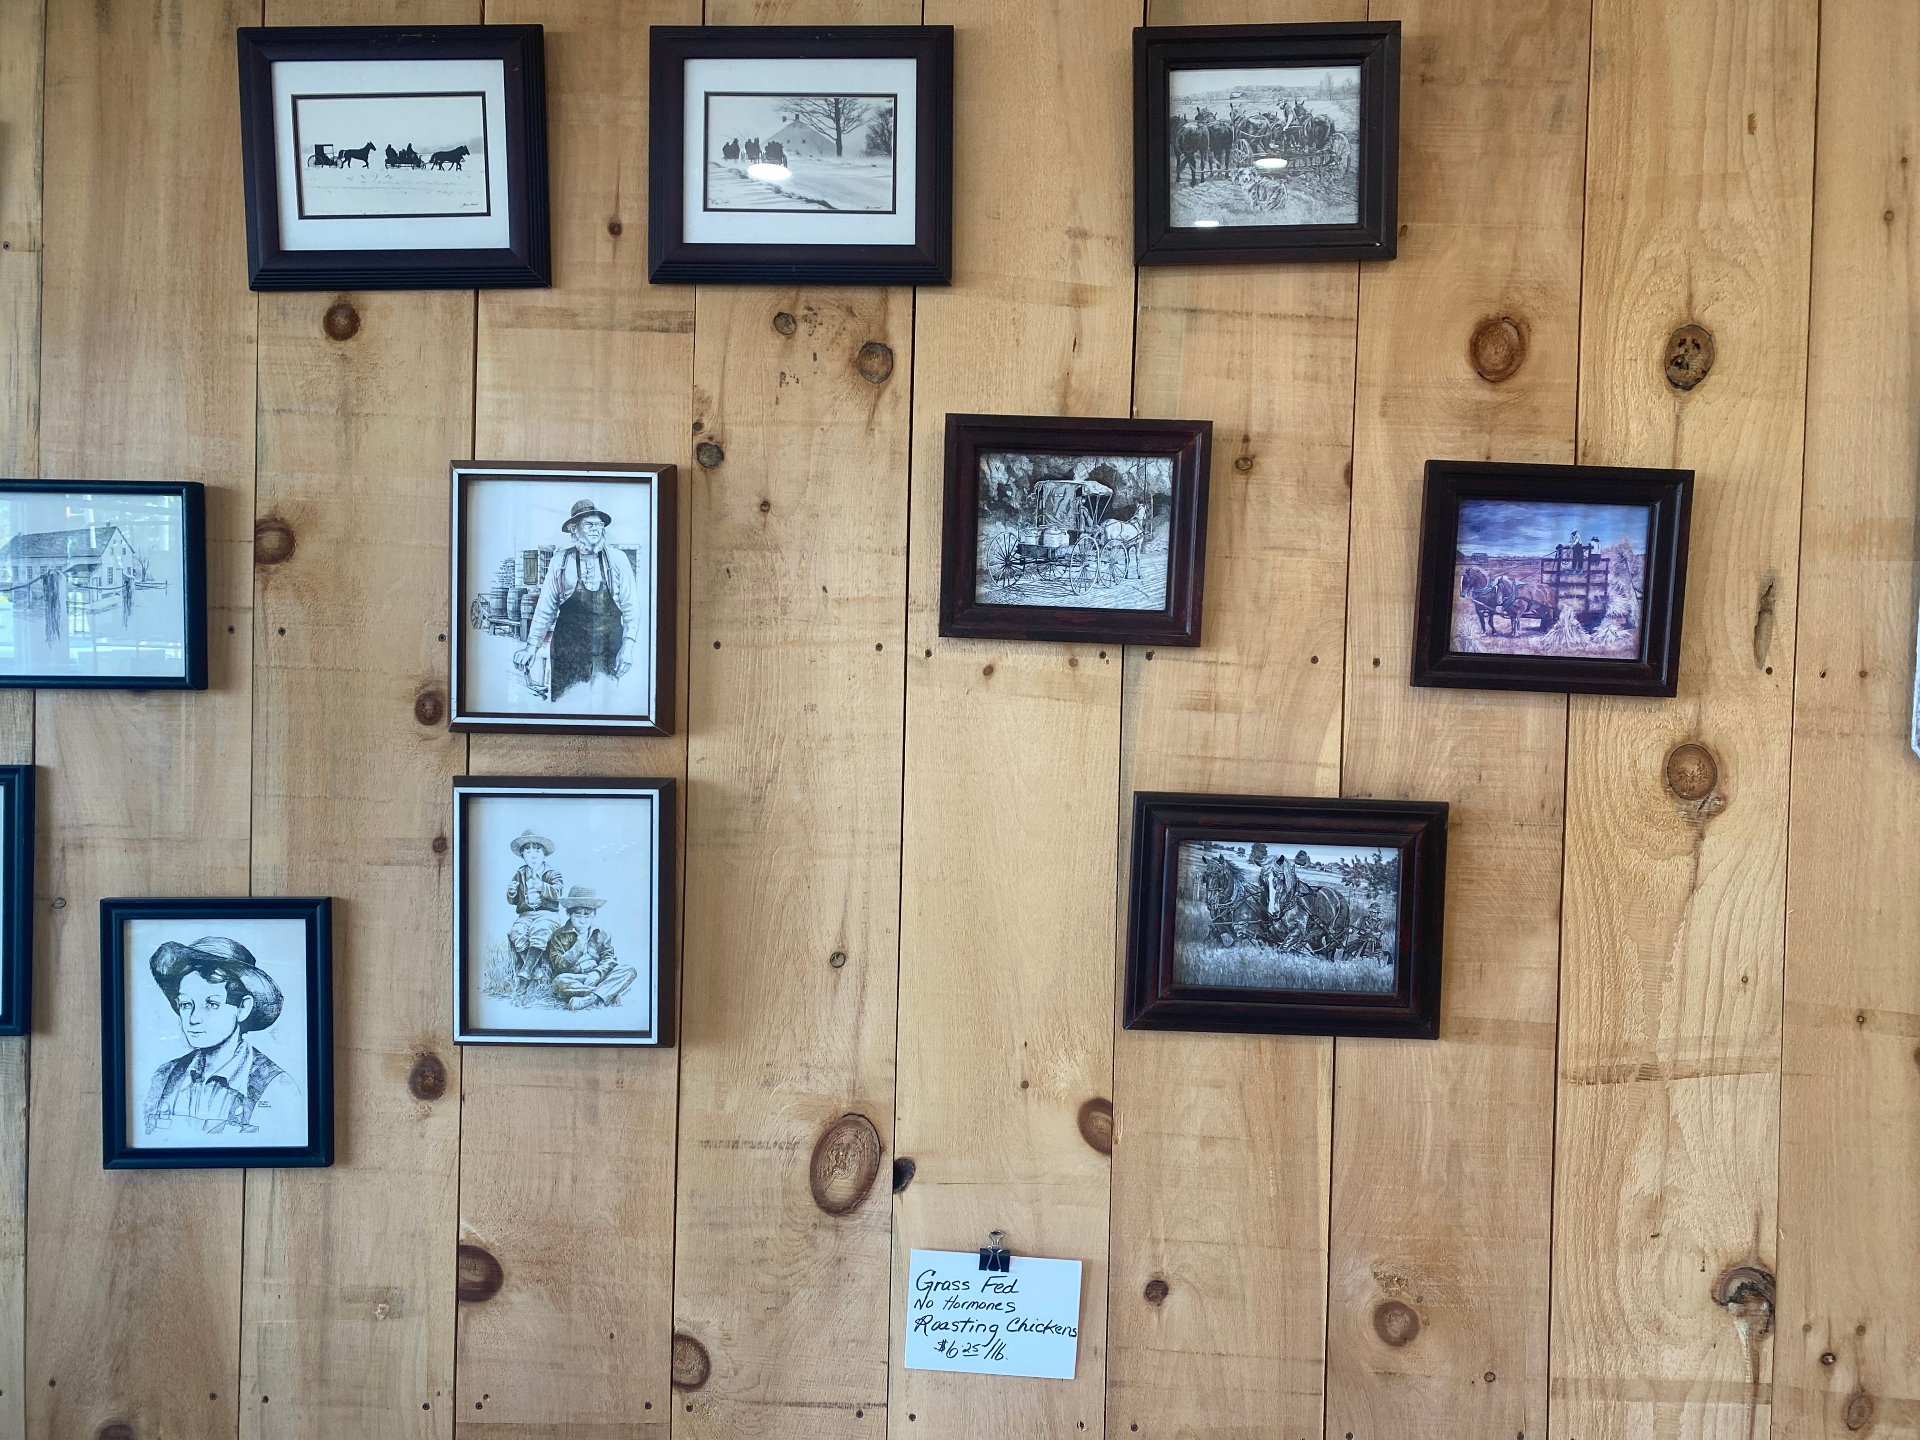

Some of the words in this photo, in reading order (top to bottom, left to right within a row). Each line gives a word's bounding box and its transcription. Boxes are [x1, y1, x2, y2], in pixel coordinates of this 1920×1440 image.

[916, 1269, 970, 1300] Grass
[981, 1276, 1019, 1294] Fed
[914, 1298, 934, 1310] No
[943, 1295, 1016, 1313] Hormones
[914, 1314, 999, 1347] Roasting
[1006, 1317, 1078, 1338] Chickens
